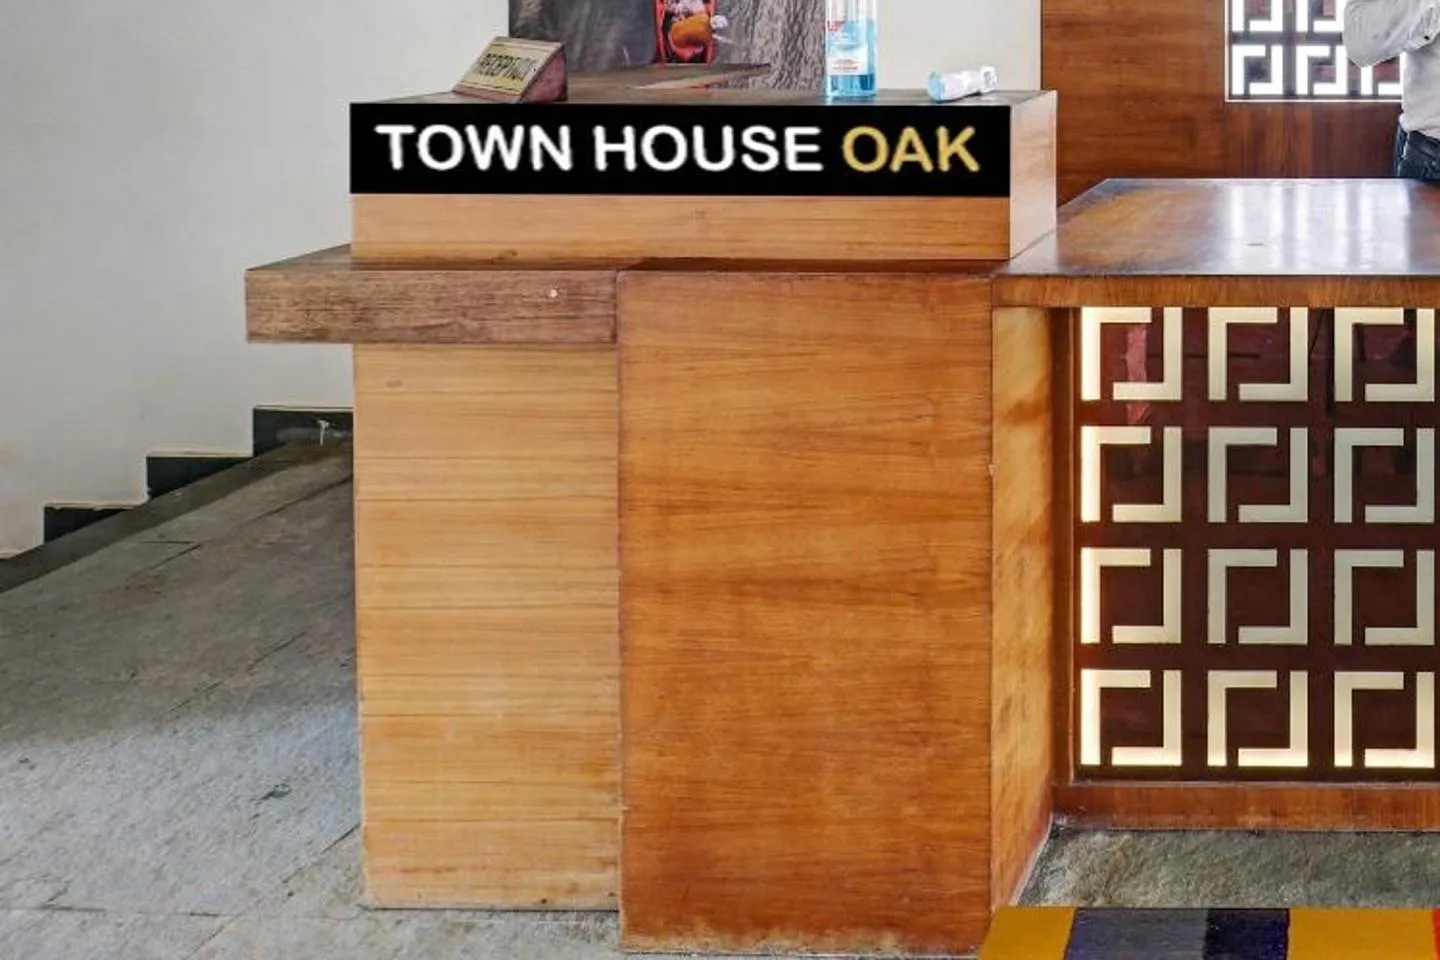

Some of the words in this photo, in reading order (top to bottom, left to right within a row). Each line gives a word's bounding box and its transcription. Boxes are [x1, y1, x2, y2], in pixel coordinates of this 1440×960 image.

[374, 124, 573, 171] TOWN
[593, 125, 824, 172] HOUSE
[842, 126, 980, 172] OAK
